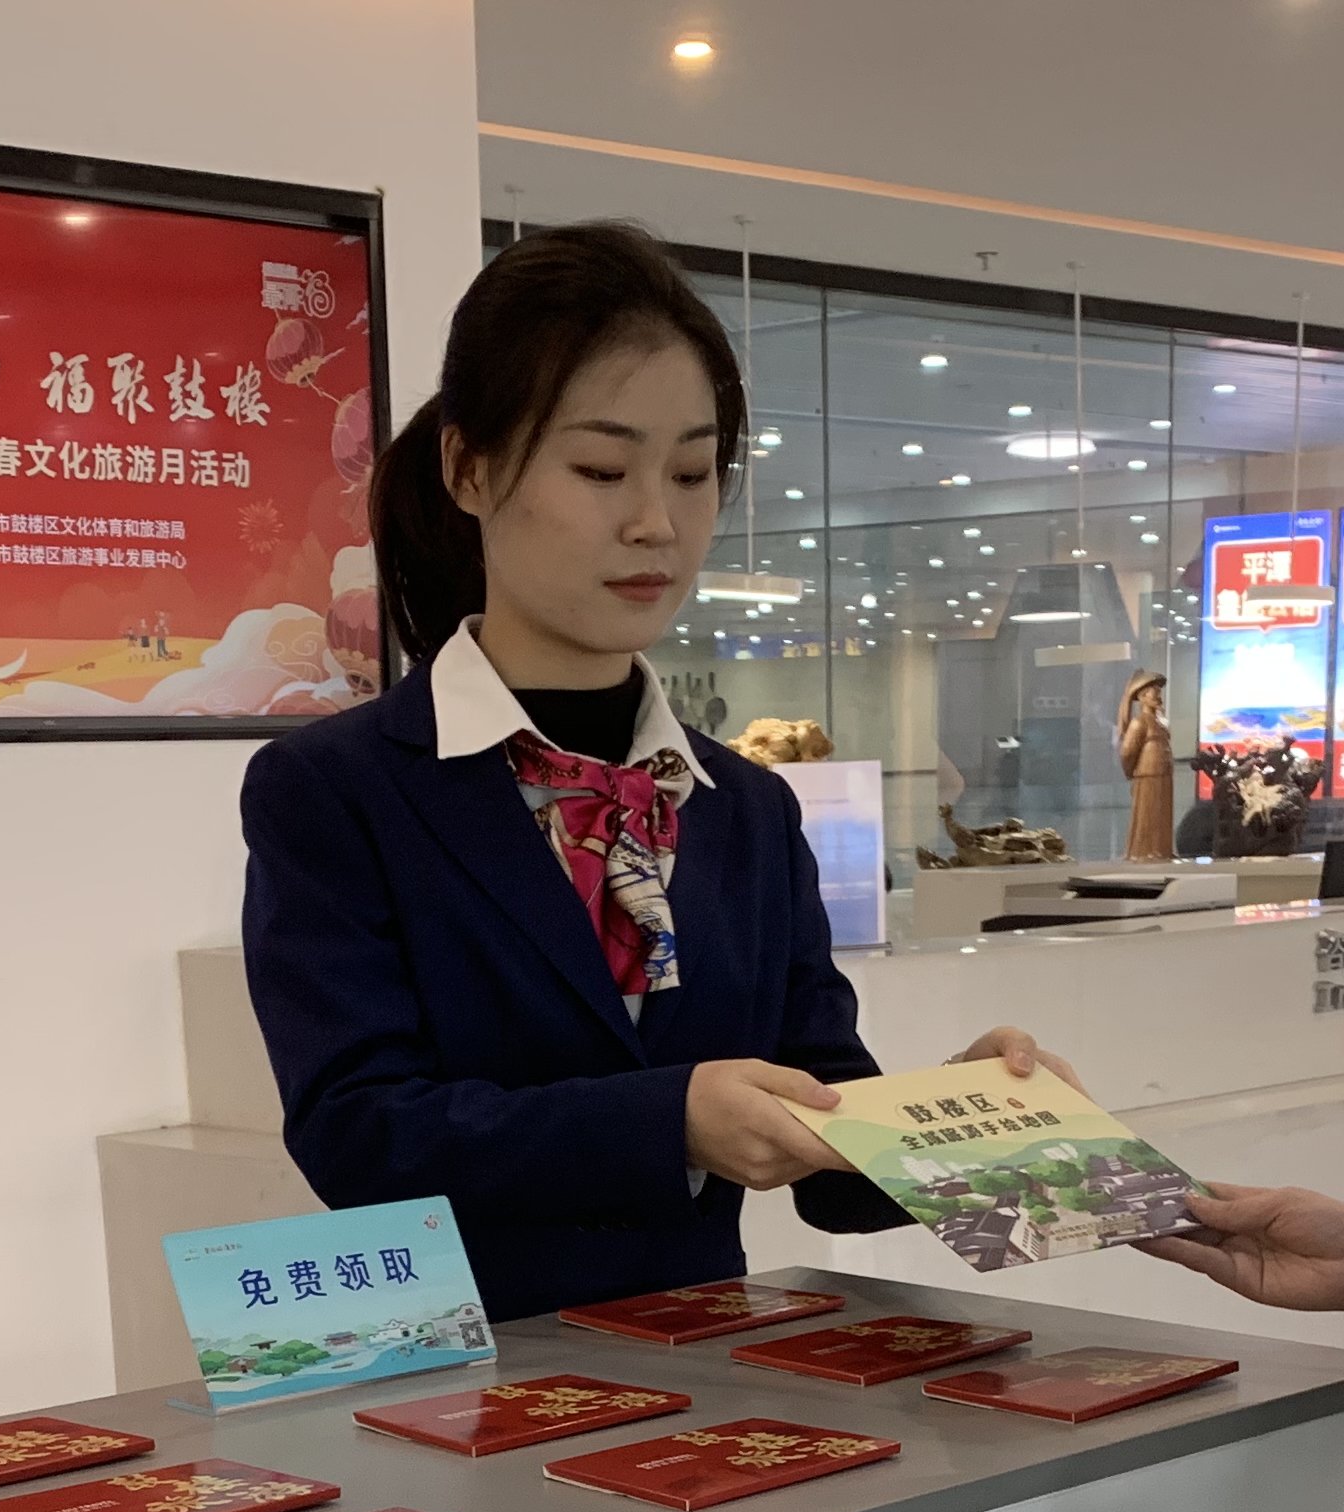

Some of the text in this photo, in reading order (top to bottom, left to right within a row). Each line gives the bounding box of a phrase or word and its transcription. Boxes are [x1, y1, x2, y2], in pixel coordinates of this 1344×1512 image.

[40, 350, 271, 427] 福聚鼓楼
[900, 1110, 1061, 1150] 全域旅游手绘地图
[902, 1093, 999, 1124] 鼓楼区
[238, 1248, 419, 1309] 免费领取
